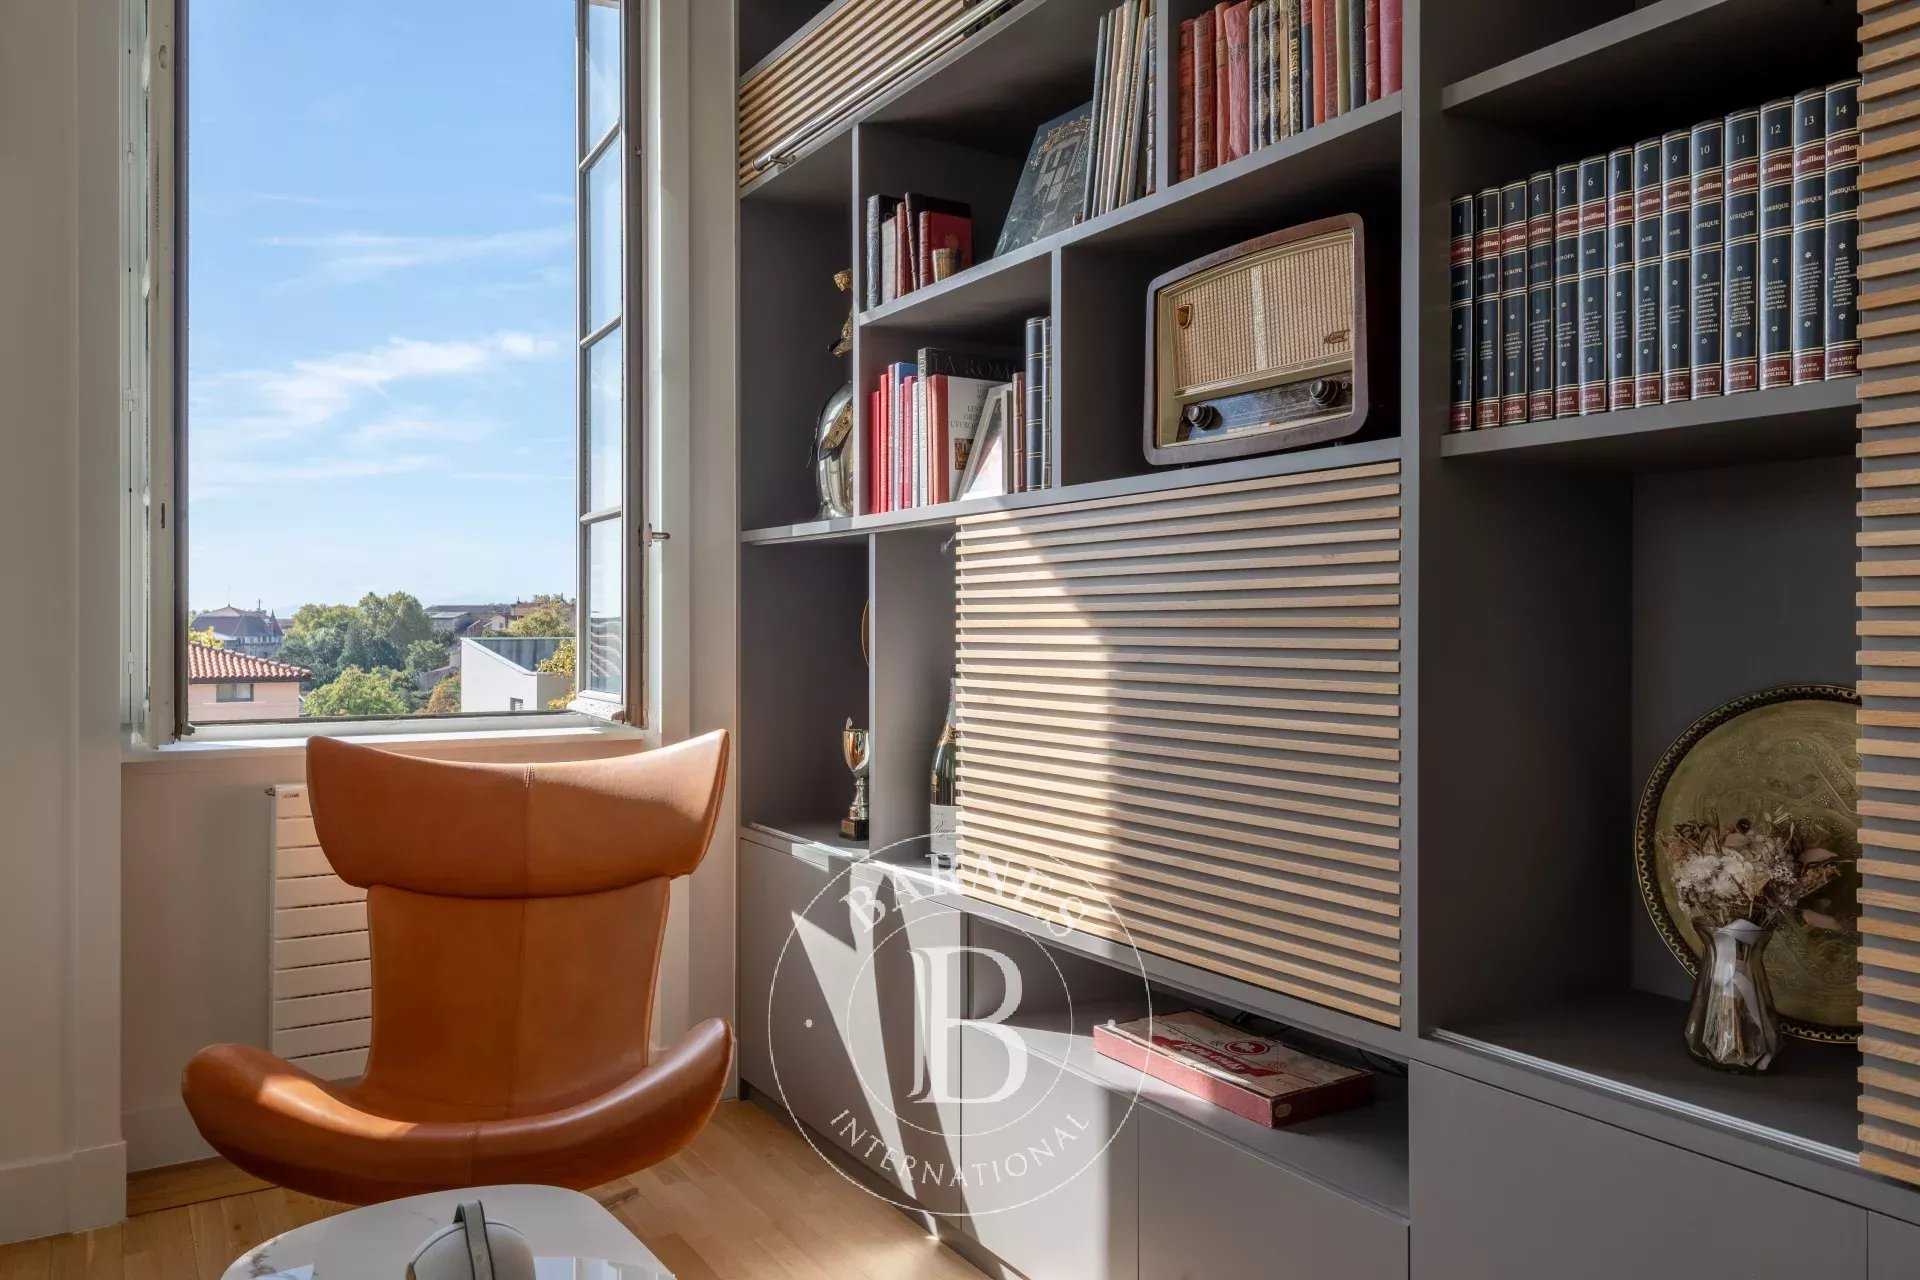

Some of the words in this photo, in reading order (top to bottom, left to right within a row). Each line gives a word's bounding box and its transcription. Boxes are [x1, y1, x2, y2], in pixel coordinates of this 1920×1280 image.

[1834, 144, 1858, 155] million
[1801, 154, 1824, 165] million
[1768, 161, 1792, 173] million
[1733, 172, 1758, 183] million
[1698, 182, 1722, 193] million
[1668, 189, 1690, 200] million
